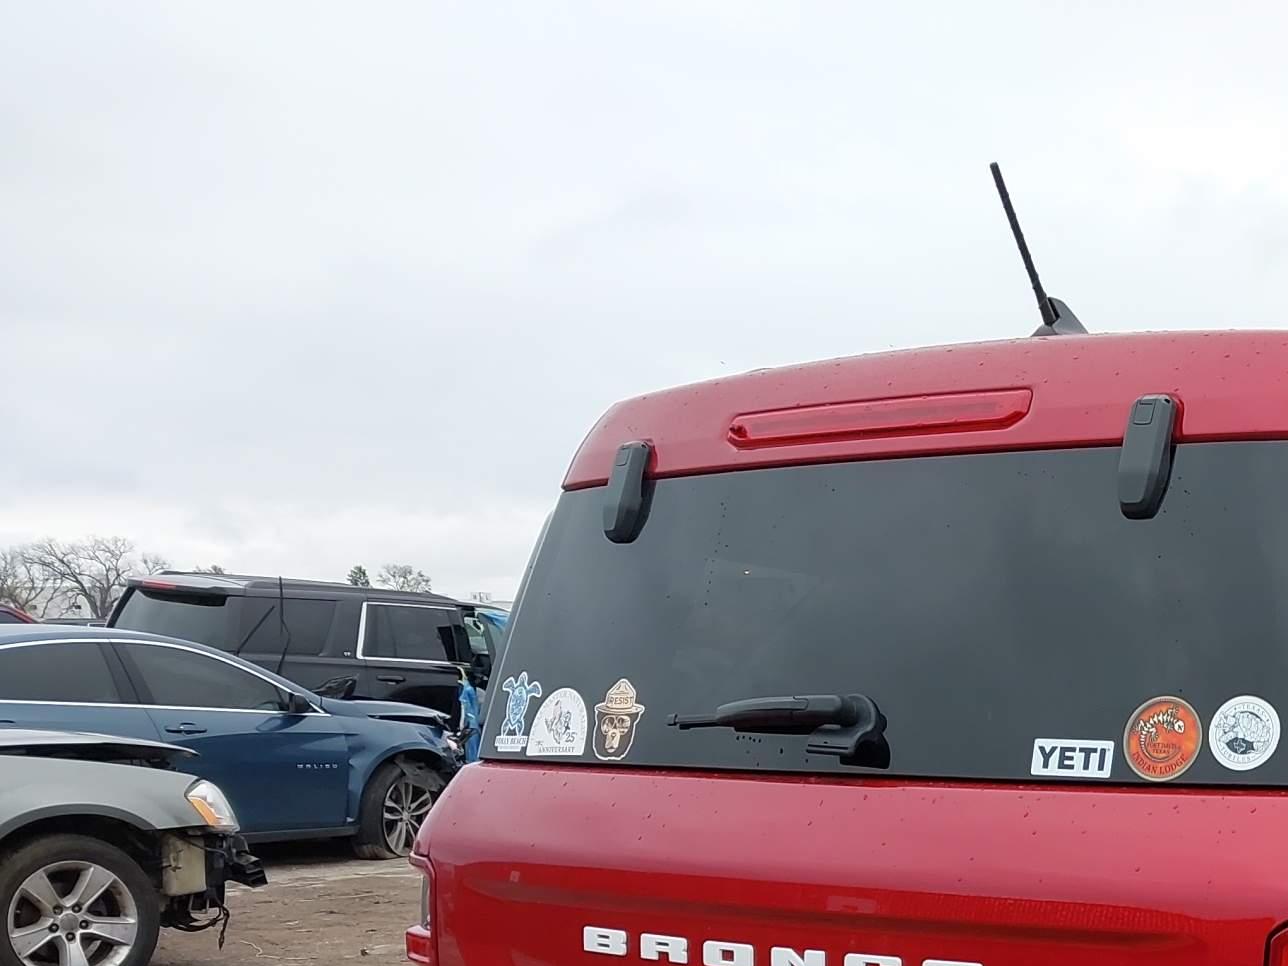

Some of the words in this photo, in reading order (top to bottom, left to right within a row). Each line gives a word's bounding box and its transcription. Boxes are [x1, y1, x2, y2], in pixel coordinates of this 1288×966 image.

[609, 696, 634, 705] RESIST
[1038, 746, 1107, 771] YETI
[1132, 751, 1157, 774] INDIAN
[1159, 753, 1186, 775] LODGE
